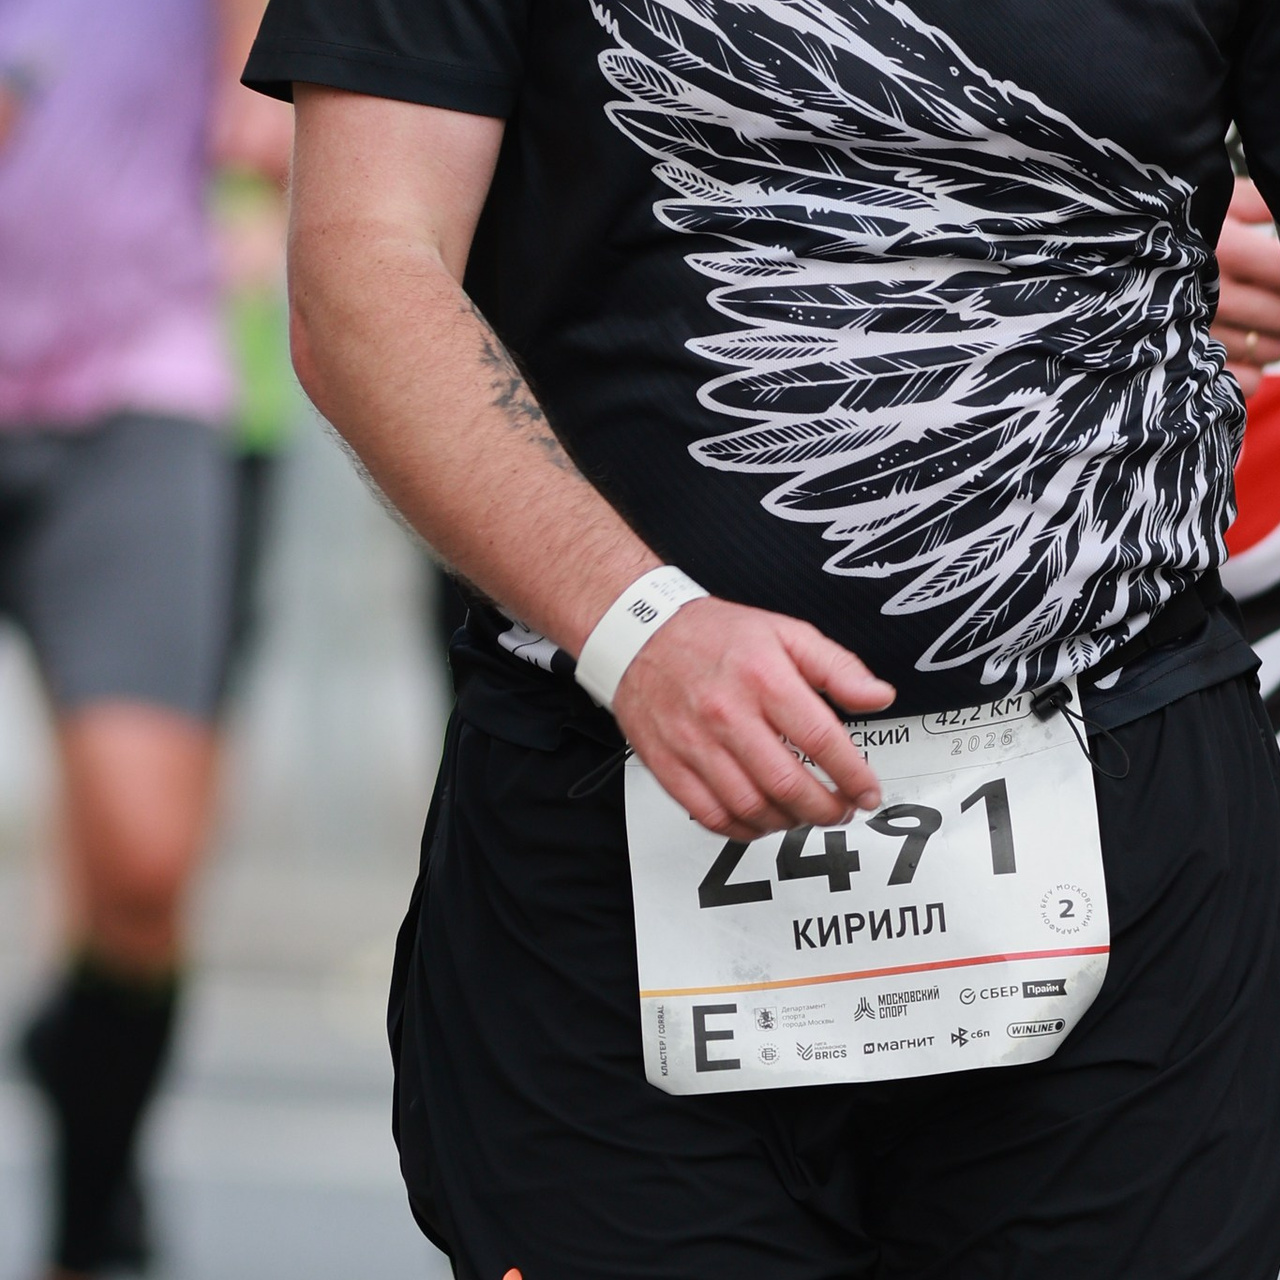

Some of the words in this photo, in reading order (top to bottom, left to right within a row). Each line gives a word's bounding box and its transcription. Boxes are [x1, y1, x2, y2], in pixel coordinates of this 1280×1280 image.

[951, 728, 1014, 756] 2026
[694, 777, 1018, 909] 2491
[1056, 883, 1093, 927] МОСКОВСКИЙ
[1058, 899, 1075, 919] 2
[791, 902, 947, 950] КИРИЛЛ
[1041, 912, 1080, 935] МАРАФОН
[877, 985, 940, 1007] МОСКОВСКИЙ
[979, 985, 1019, 1000] СБЕР
[1026, 983, 1060, 995] Прайм
[781, 1002, 827, 1014] Департамент
[782, 1013, 806, 1021] спорта
[879, 1004, 908, 1020] СПОРТ
[657, 1005, 665, 1034] CORRAL
[782, 1020, 807, 1029] города
[807, 1018, 835, 1026] Москвы
[1011, 1023, 1054, 1035] WINLINE
[692, 1003, 741, 1073] E
[877, 1035, 935, 1052] магнит
[970, 1029, 990, 1039] сбп
[657, 1041, 668, 1077] КЛАСТЕР
[815, 1049, 848, 1060] BRICS
